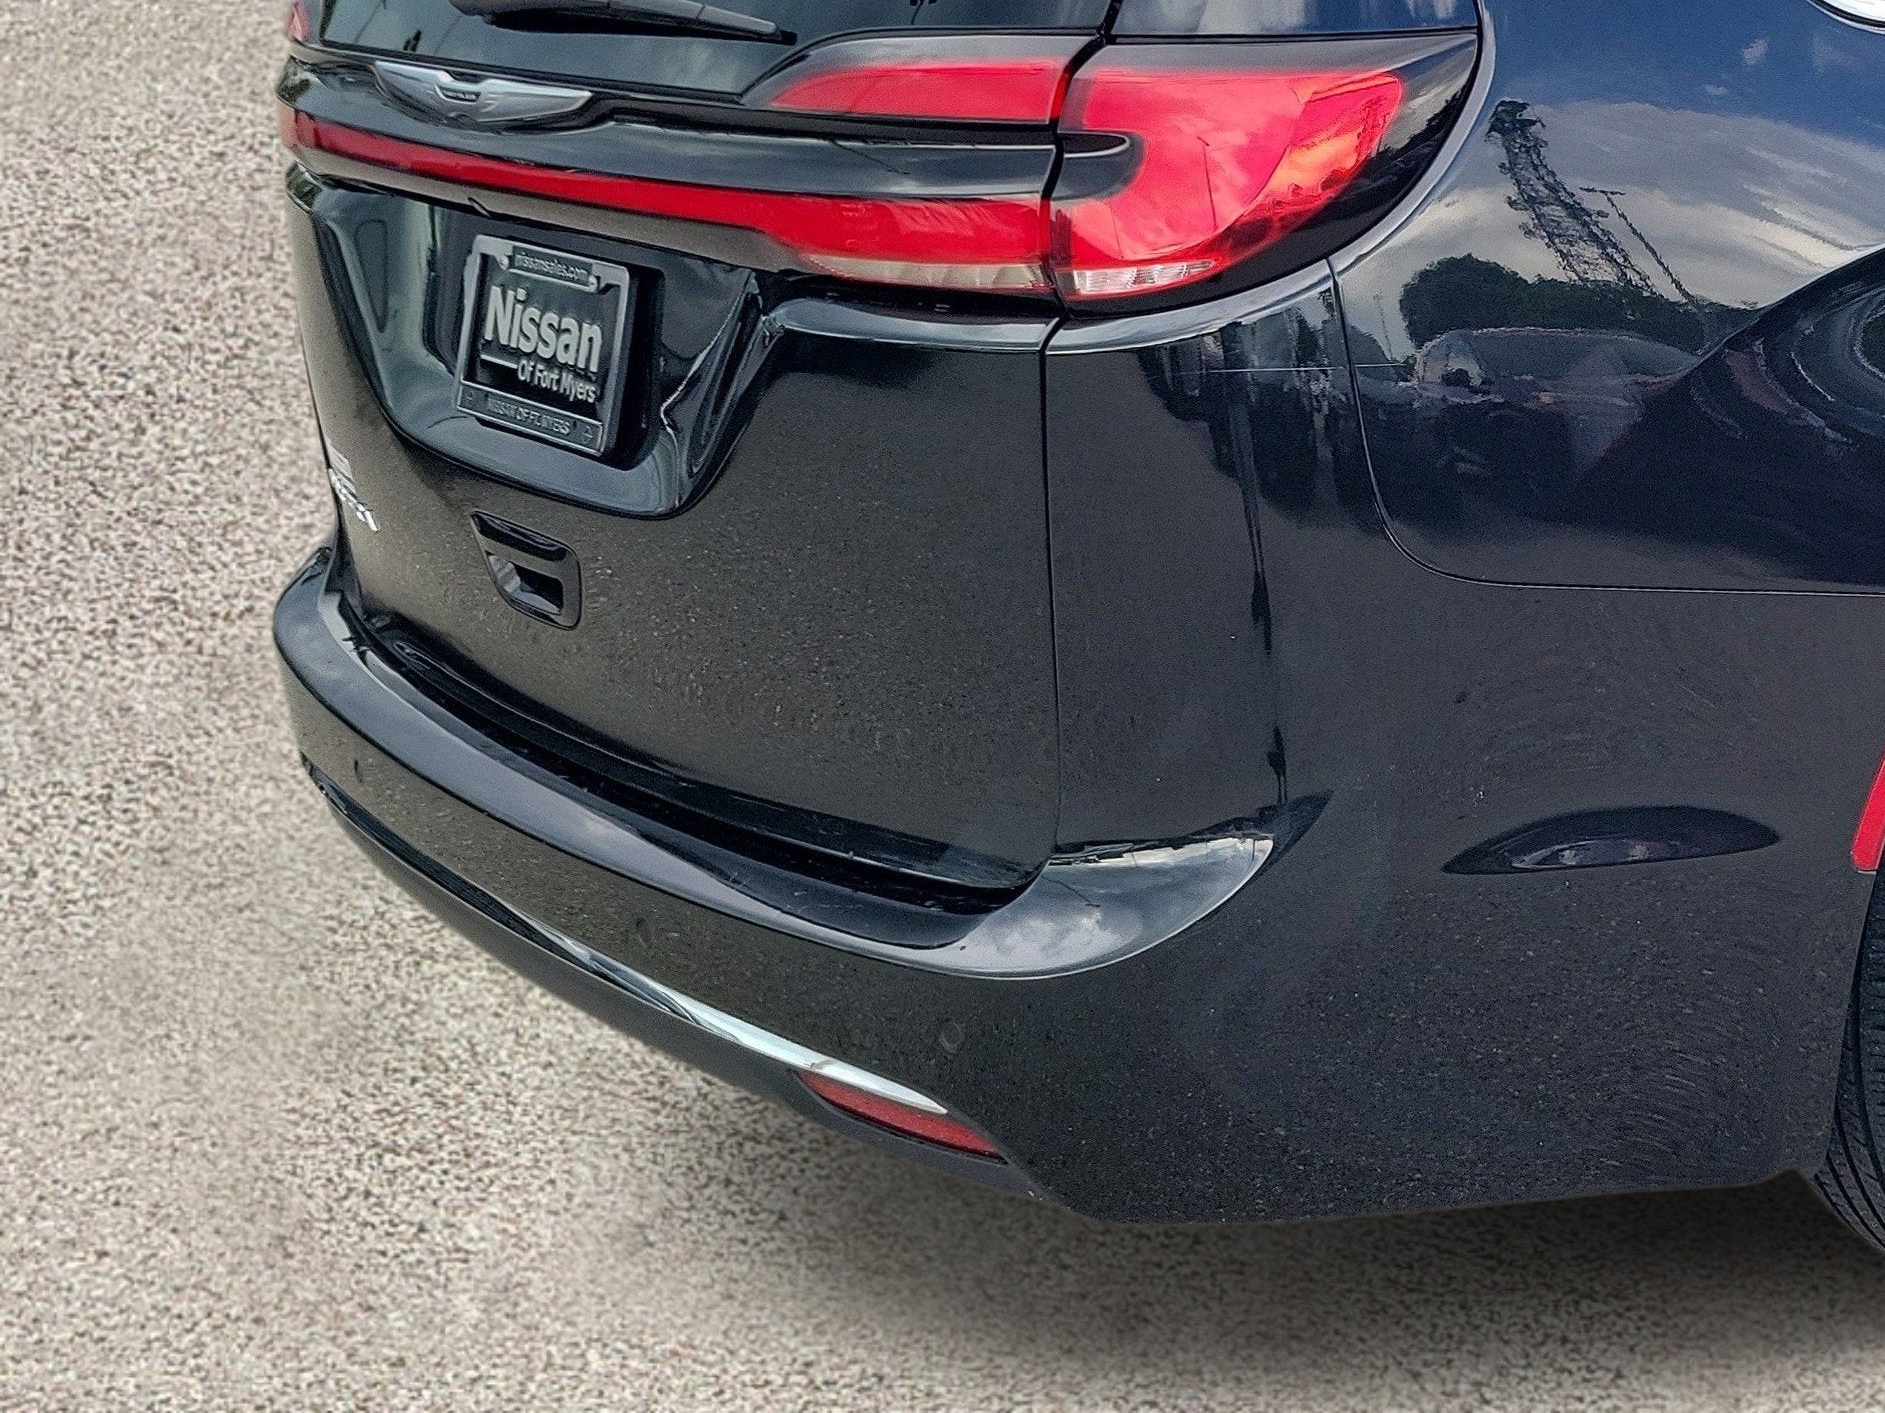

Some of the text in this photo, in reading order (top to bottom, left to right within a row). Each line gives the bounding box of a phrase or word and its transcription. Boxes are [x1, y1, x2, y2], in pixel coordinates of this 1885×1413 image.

[484, 285, 603, 373] Nissan
[517, 359, 597, 403] Of Fort Myers
